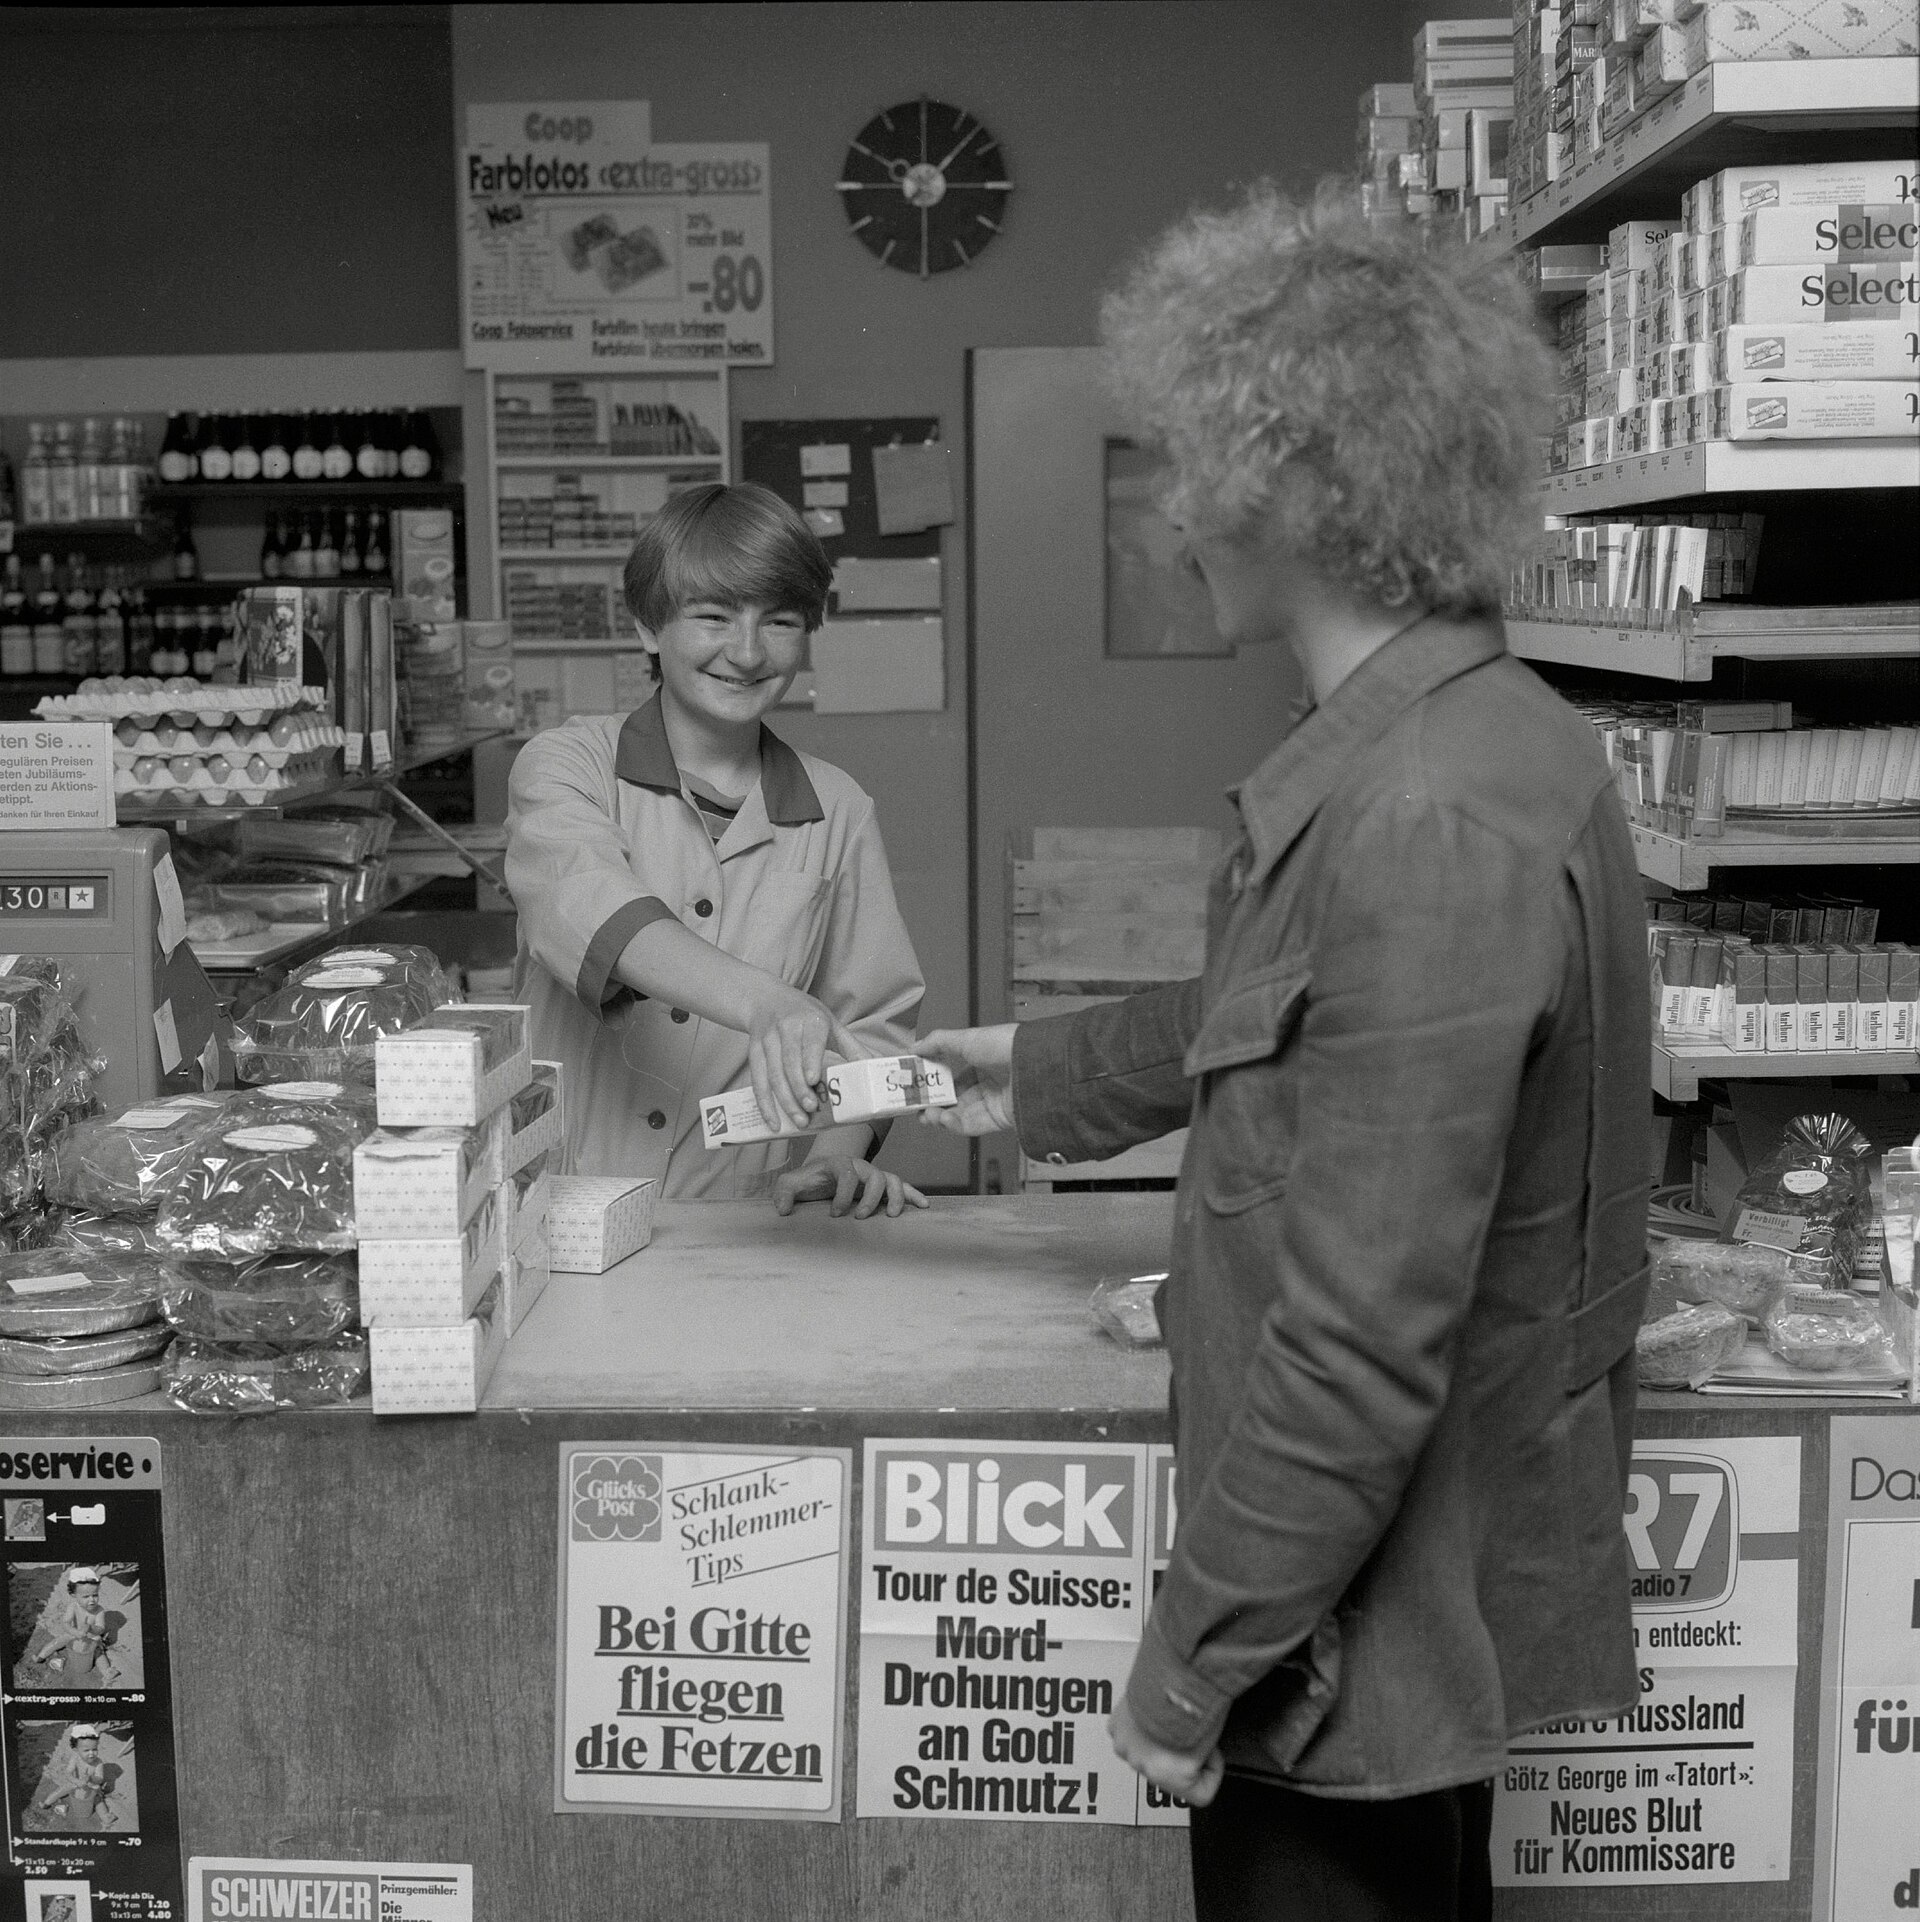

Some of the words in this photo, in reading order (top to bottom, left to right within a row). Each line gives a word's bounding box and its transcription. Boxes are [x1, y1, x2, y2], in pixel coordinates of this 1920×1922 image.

[524, 111, 594, 146] Coop
[1815, 216, 1920, 251] Selec
[1801, 273, 1920, 306] Select
[35, 733, 63, 749] Sie
[25, 769, 86, 779] Jubiläums-
[51, 756, 93, 767] Preisen
[35, 783, 48, 792] zu
[51, 781, 98, 792] Aktions-
[67, 810, 99, 818] Einkauf
[1741, 1011, 1754, 1043] Marlboro
[1780, 1011, 1793, 1043] Marlboro
[1810, 1011, 1823, 1043] Marlboro
[1832, 1010, 1846, 1042] Marlboro
[1870, 1010, 1883, 1042] Marlboro
[1893, 1009, 1907, 1041] Marlboro
[886, 1069, 943, 1092] Sect
[1749, 1212, 1790, 1228] Verbilligt
[0, 1445, 134, 1480] oservice
[587, 1479, 647, 1500] Glücks
[1850, 1457, 1920, 1501] Da
[597, 1499, 635, 1517] Post
[671, 1471, 790, 1521] Schlank-
[885, 1459, 1126, 1549] Blick
[680, 1498, 833, 1551] Schlemmer-
[687, 1553, 744, 1585] Tips
[873, 1565, 947, 1602] Tour
[956, 1567, 998, 1605] de
[1008, 1568, 1131, 1610] Suisse:
[1678, 1574, 1692, 1597] 7
[596, 1605, 677, 1652] Bei
[690, 1606, 811, 1656] Gitte
[935, 1615, 1063, 1662] Mord-
[1649, 1620, 1742, 1648] entdeckt:
[617, 1664, 784, 1724] fliegen
[884, 1662, 1112, 1718] Drohungen
[575, 1723, 648, 1770] die
[660, 1725, 822, 1777] Fetzen
[918, 1723, 969, 1762] an
[981, 1718, 1075, 1765] Godi
[893, 1765, 1099, 1815] Schmutz!
[1504, 1766, 1550, 1792] Götz
[1557, 1765, 1627, 1793] George
[1635, 1763, 1658, 1788] im
[1665, 1761, 1754, 1787] «Tatort»:
[1550, 1800, 1638, 1836] Neues
[1647, 1797, 1703, 1833] Blut
[24, 1837, 77, 1847] Standardkopie
[1513, 1838, 1554, 1875] für
[1562, 1835, 1736, 1874] Kommissare
[24, 1866, 48, 1875] 2.50
[108, 1892, 130, 1901] Kopie
[131, 1892, 141, 1900] ab
[141, 1892, 155, 1900] Dia
[148, 1900, 170, 1909] 1.20
[211, 1877, 372, 1920] SCHWEIZER
[381, 1900, 403, 1914] Die
